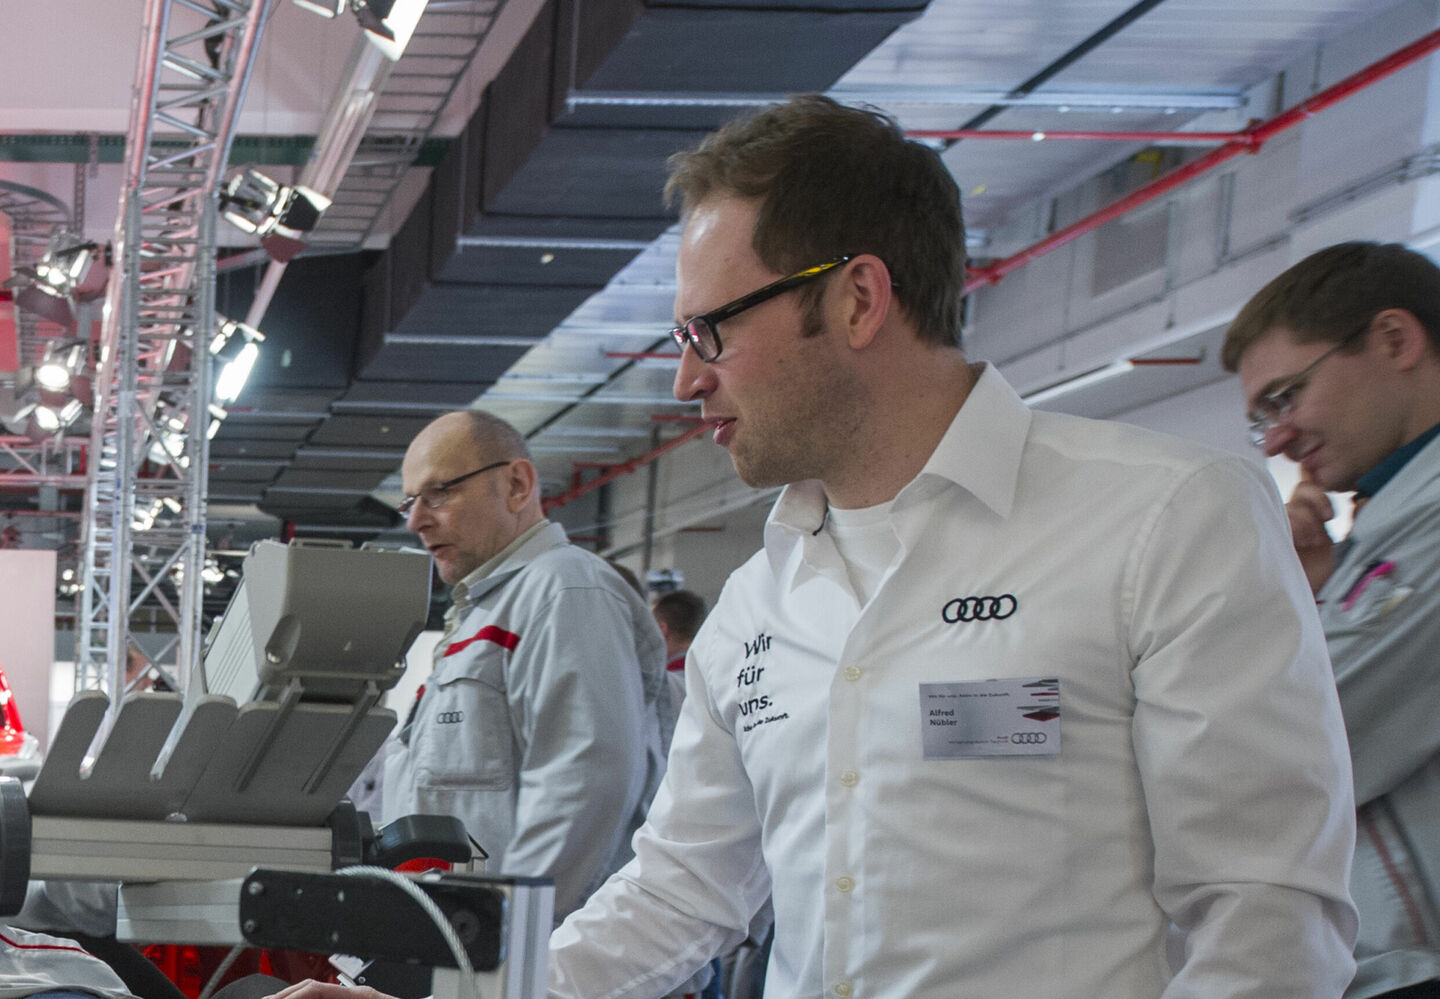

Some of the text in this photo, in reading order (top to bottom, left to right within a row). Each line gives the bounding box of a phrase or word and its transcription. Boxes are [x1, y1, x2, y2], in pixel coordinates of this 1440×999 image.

[744, 633, 772, 659] Wir
[737, 665, 765, 688] für
[738, 695, 773, 716] uns.
[929, 709, 955, 717] Alfred
